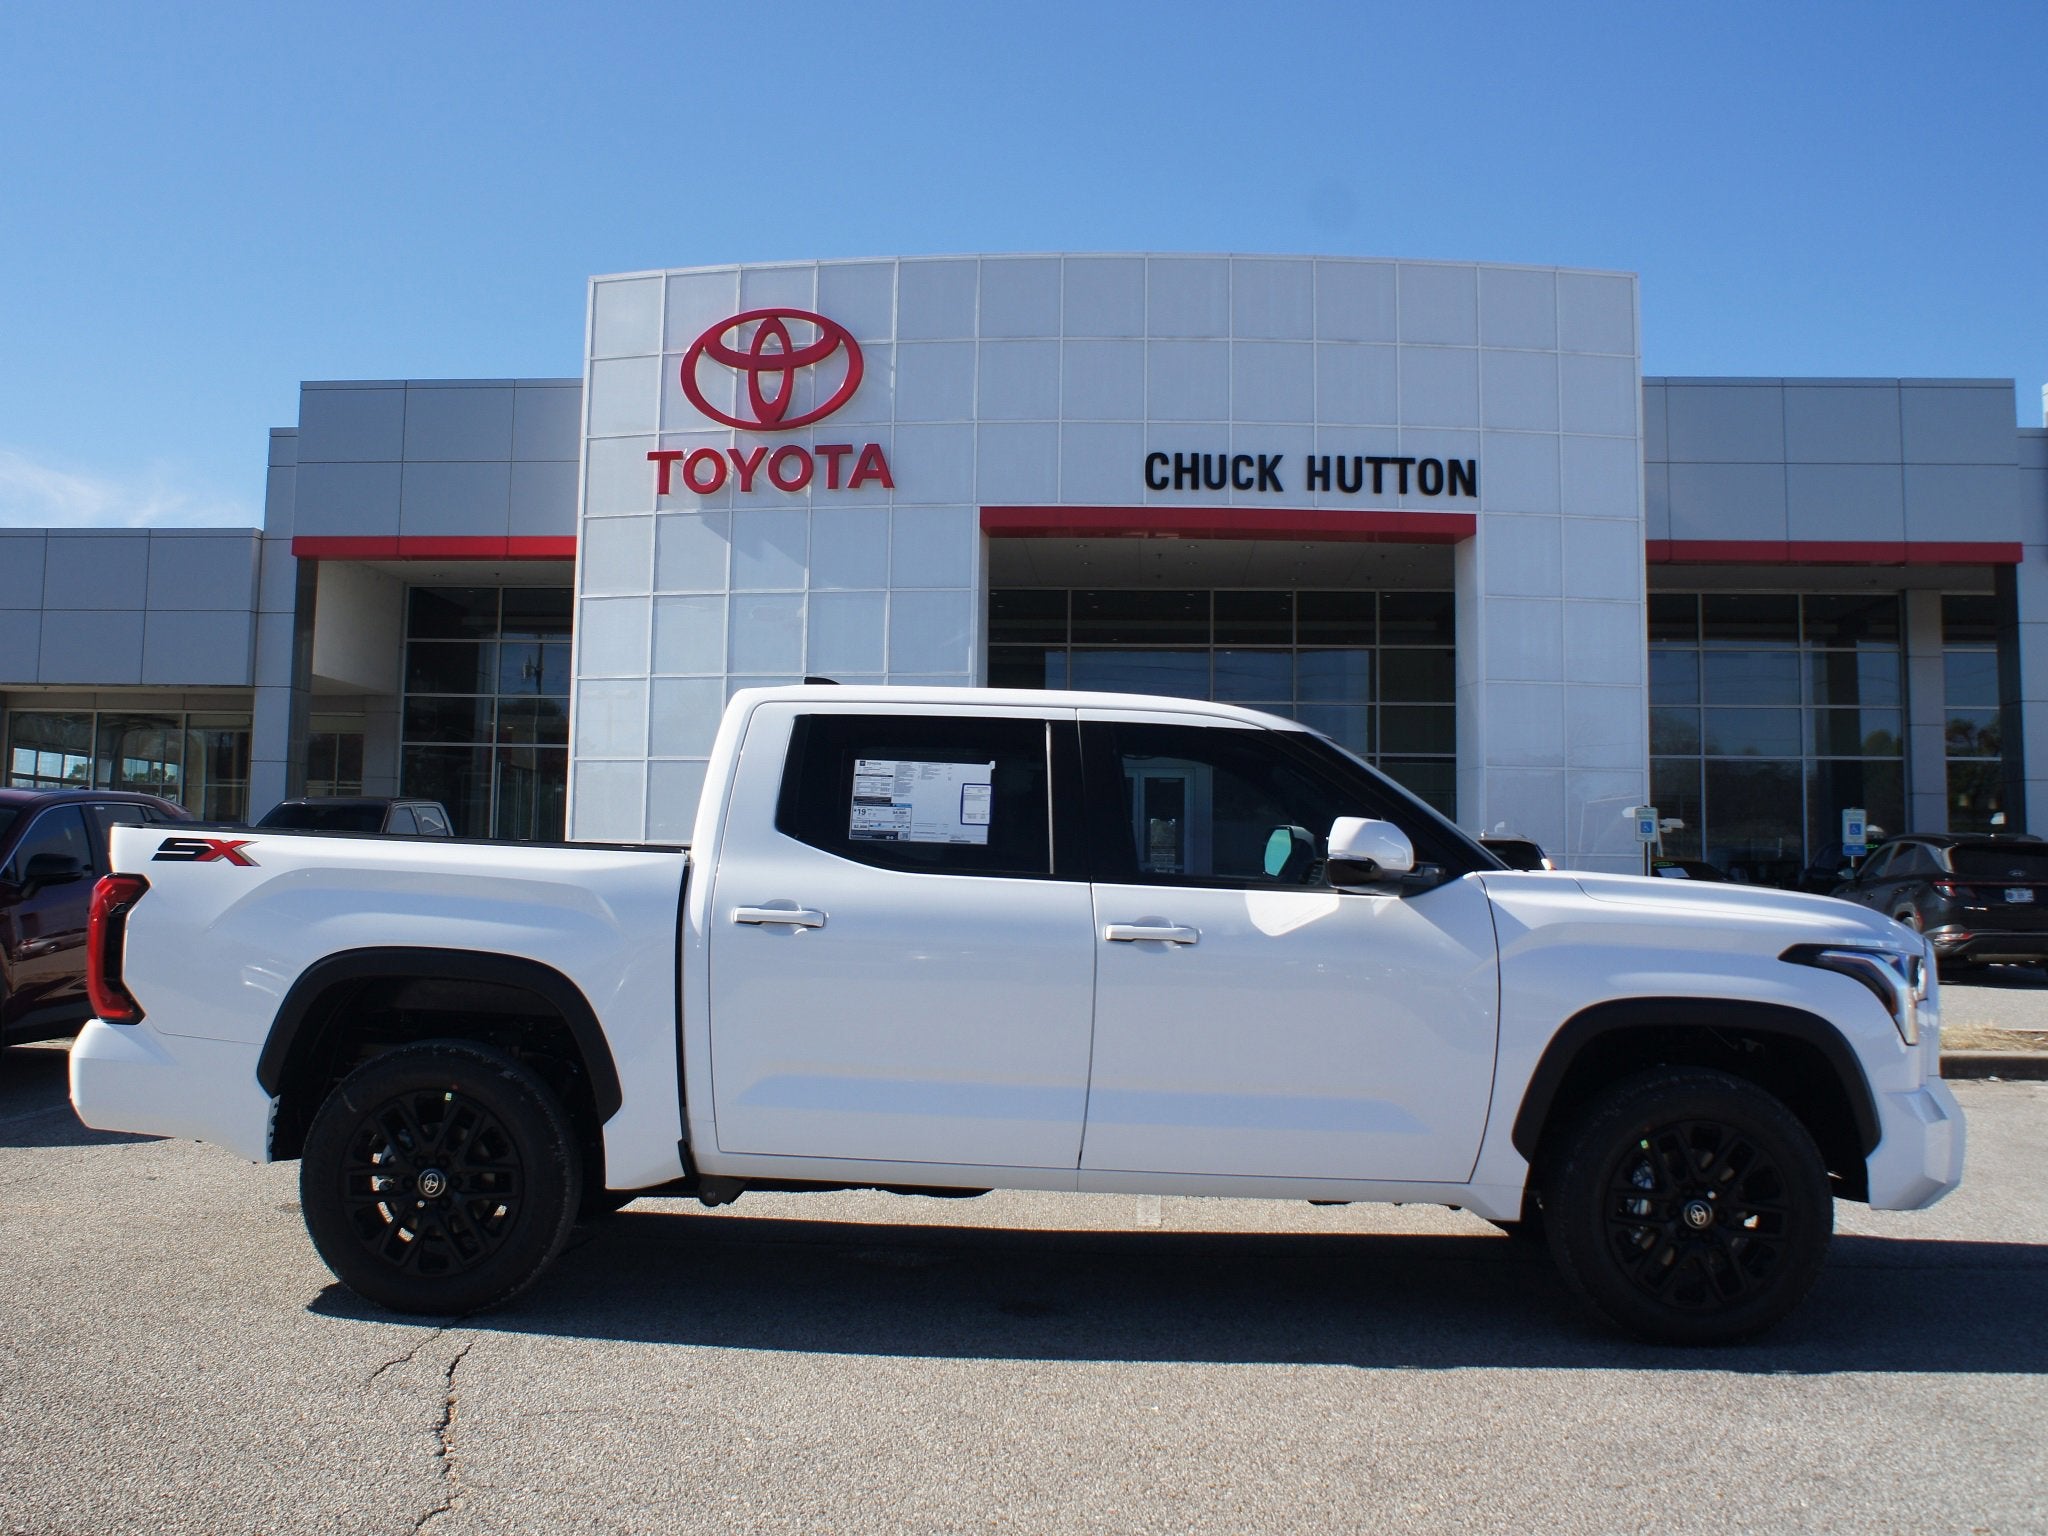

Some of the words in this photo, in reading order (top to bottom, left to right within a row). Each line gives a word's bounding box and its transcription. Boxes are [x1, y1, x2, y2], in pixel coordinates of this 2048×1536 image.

[647, 443, 895, 495] TOYOTA
[1145, 452, 1284, 492] CHUCK
[1307, 455, 1477, 498] HUTTON
[151, 837, 261, 867] SX
